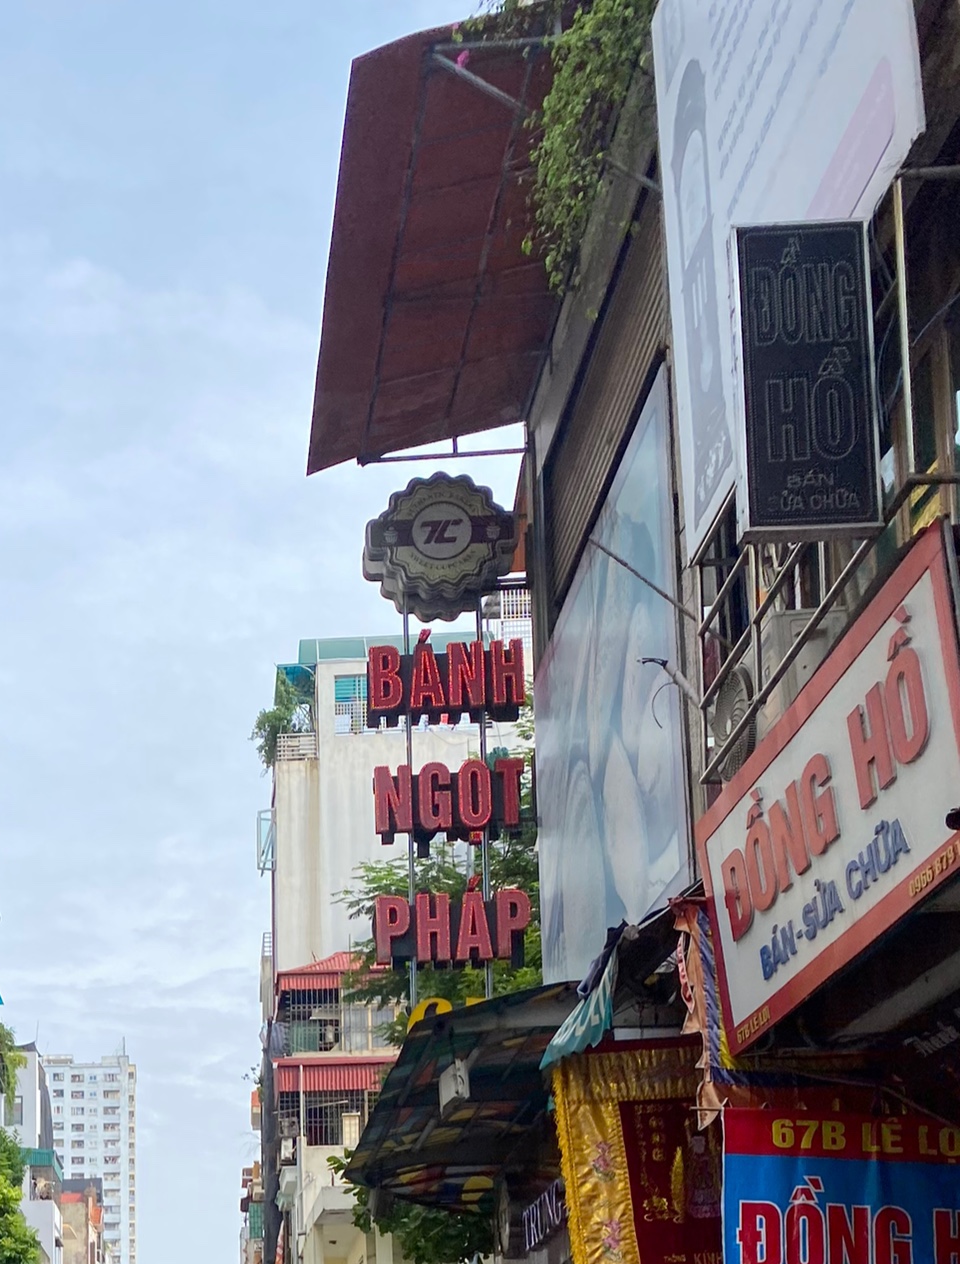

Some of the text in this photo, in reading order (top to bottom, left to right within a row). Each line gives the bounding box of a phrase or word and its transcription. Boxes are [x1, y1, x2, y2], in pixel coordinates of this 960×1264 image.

[368, 628, 525, 712] BÁNH
[373, 757, 525, 844] NGỌT
[721, 604, 931, 942] ĐỒNG HỒ
[845, 818, 911, 901] CHỮA
[908, 865, 934, 897] 0966
[375, 875, 531, 966] PHÁP
[772, 1118, 846, 1151] 67B
[862, 1117, 904, 1153] LÊ
